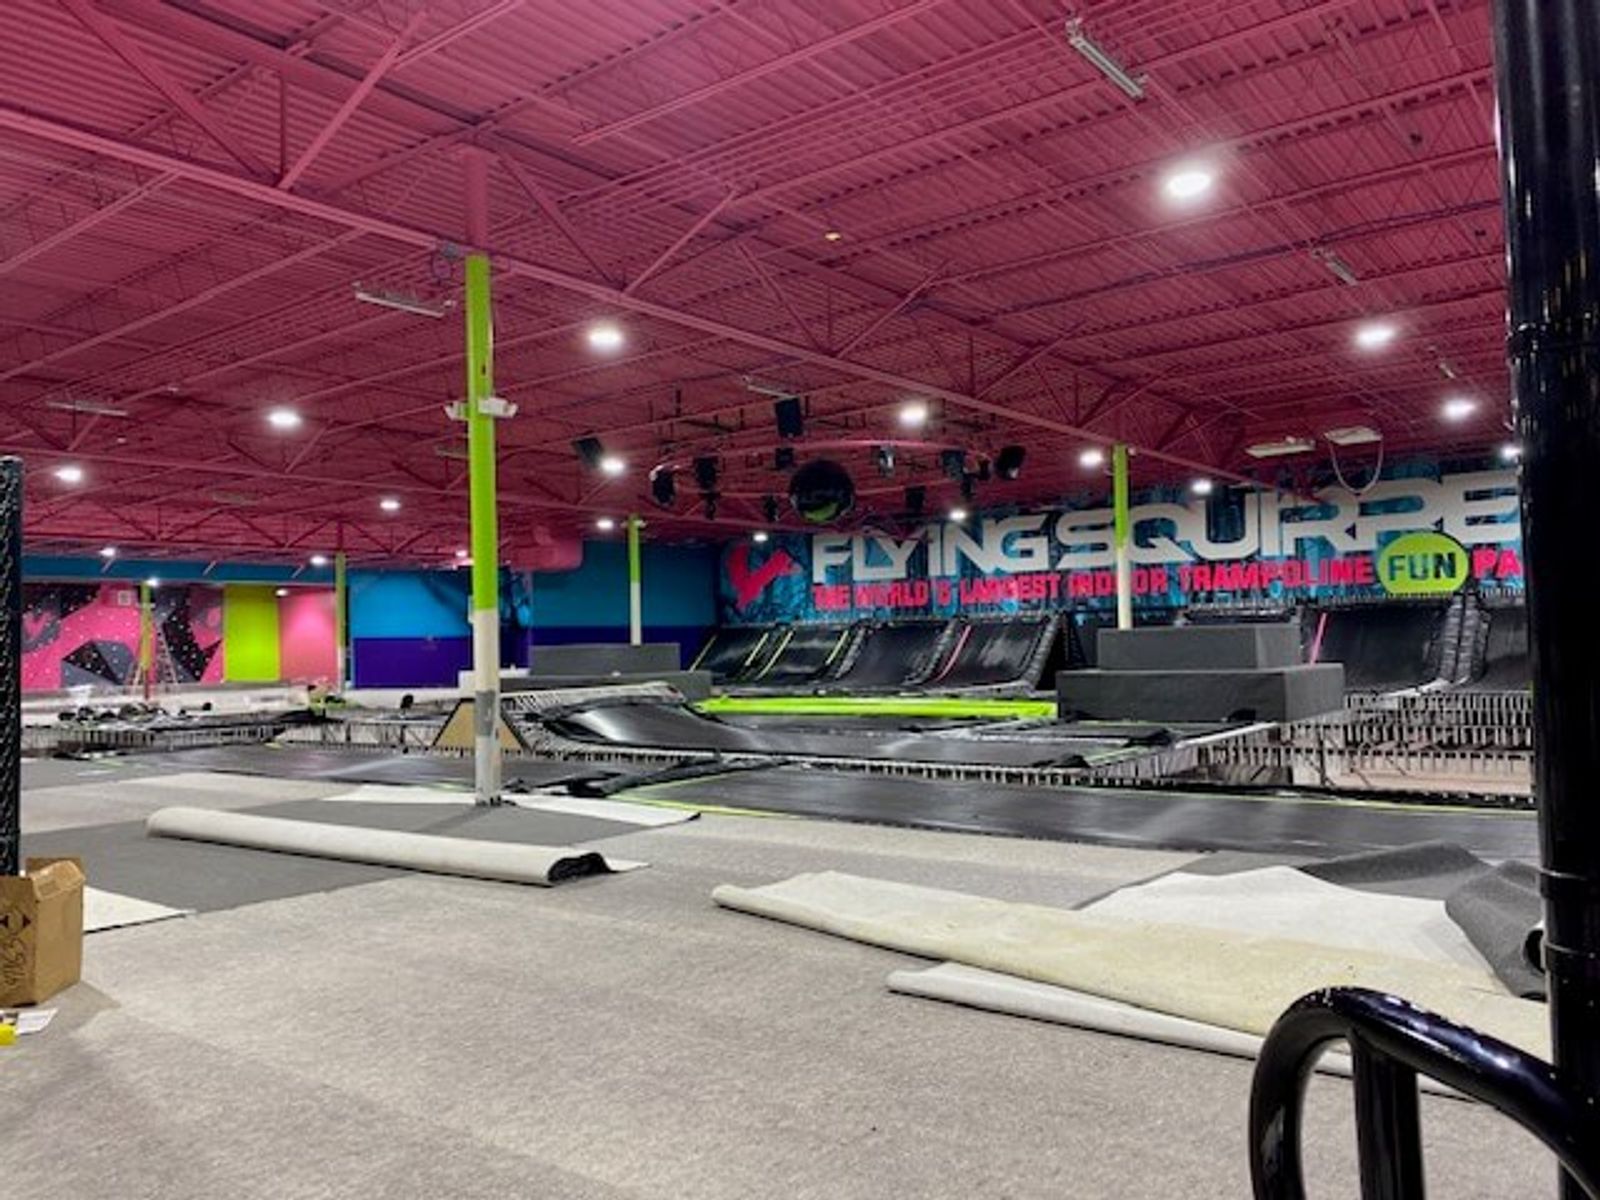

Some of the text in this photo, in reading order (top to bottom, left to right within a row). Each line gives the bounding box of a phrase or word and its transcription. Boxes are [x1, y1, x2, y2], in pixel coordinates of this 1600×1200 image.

[812, 514, 1050, 585] FLYING
[1068, 565, 1168, 599] INDOR
[1178, 554, 1376, 592] TRAMPOLINE
[1387, 551, 1457, 582] FUN
